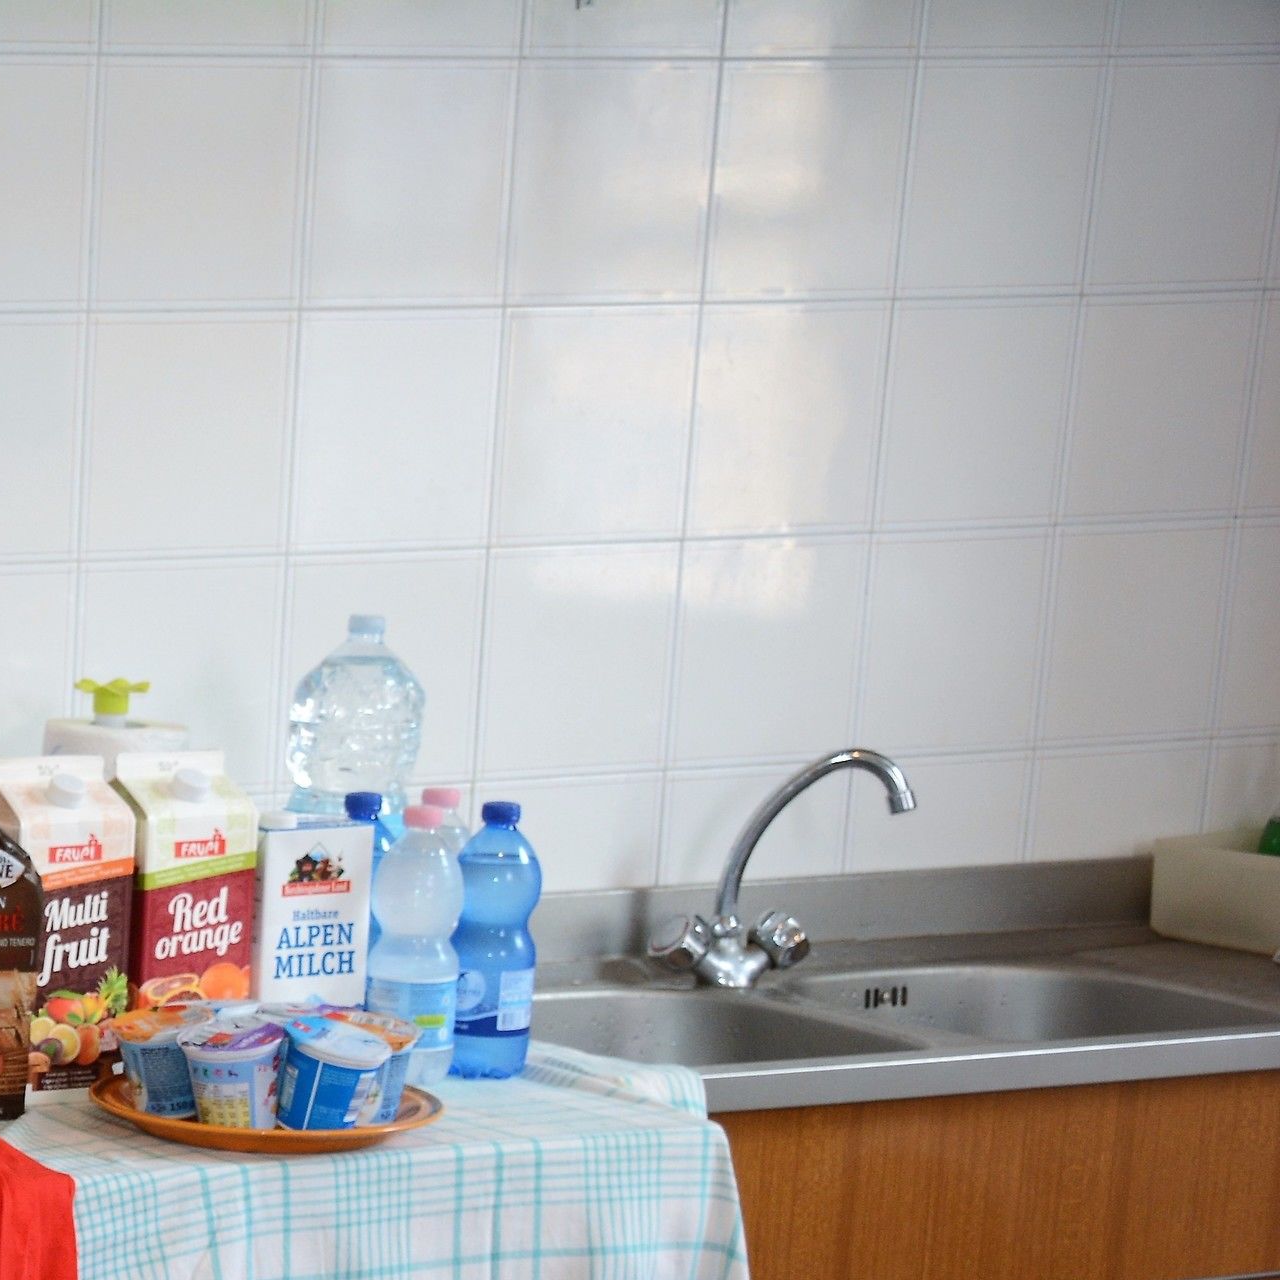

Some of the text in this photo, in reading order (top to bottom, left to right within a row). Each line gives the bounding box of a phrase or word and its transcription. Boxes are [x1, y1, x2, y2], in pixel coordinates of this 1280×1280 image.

[44, 891, 109, 933] Multi
[167, 885, 229, 933] Red
[292, 908, 339, 920] Haltbare
[154, 920, 243, 960] orange
[276, 922, 354, 950] ALPEN
[36, 927, 111, 987] fruit
[273, 951, 355, 979] MILCH
